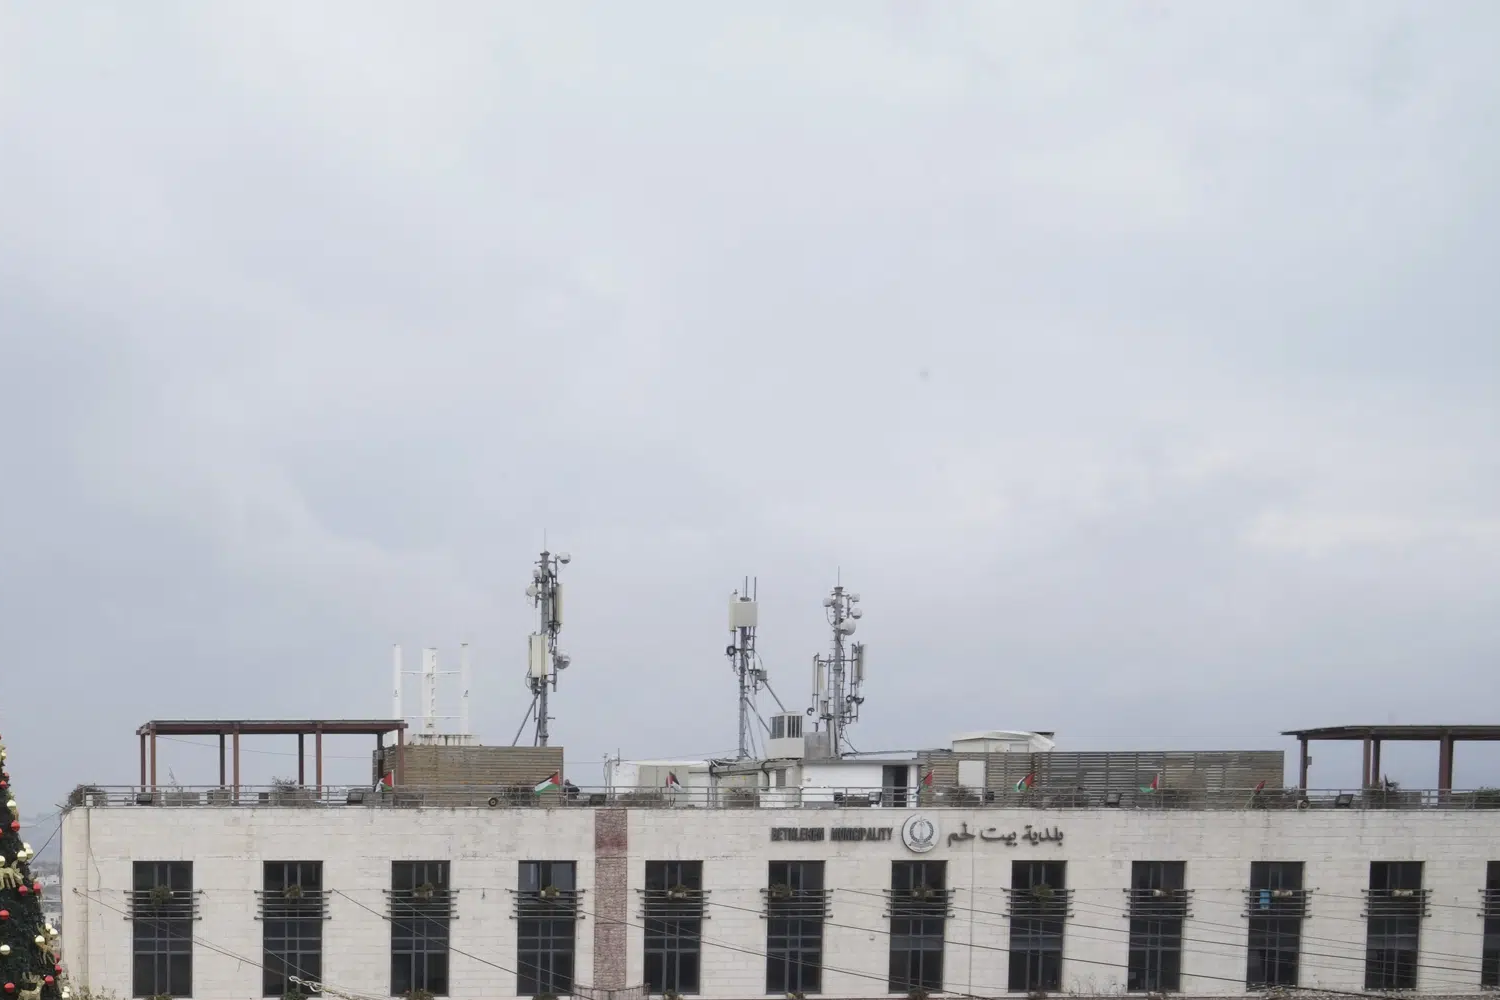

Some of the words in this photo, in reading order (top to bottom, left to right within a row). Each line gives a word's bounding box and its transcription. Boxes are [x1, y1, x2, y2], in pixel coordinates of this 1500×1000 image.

[830, 826, 893, 842] MUNICIPALITY
[947, 821, 976, 848] لحم
[980, 827, 1018, 847] بيت
[1022, 824, 1064, 847] بلدية
